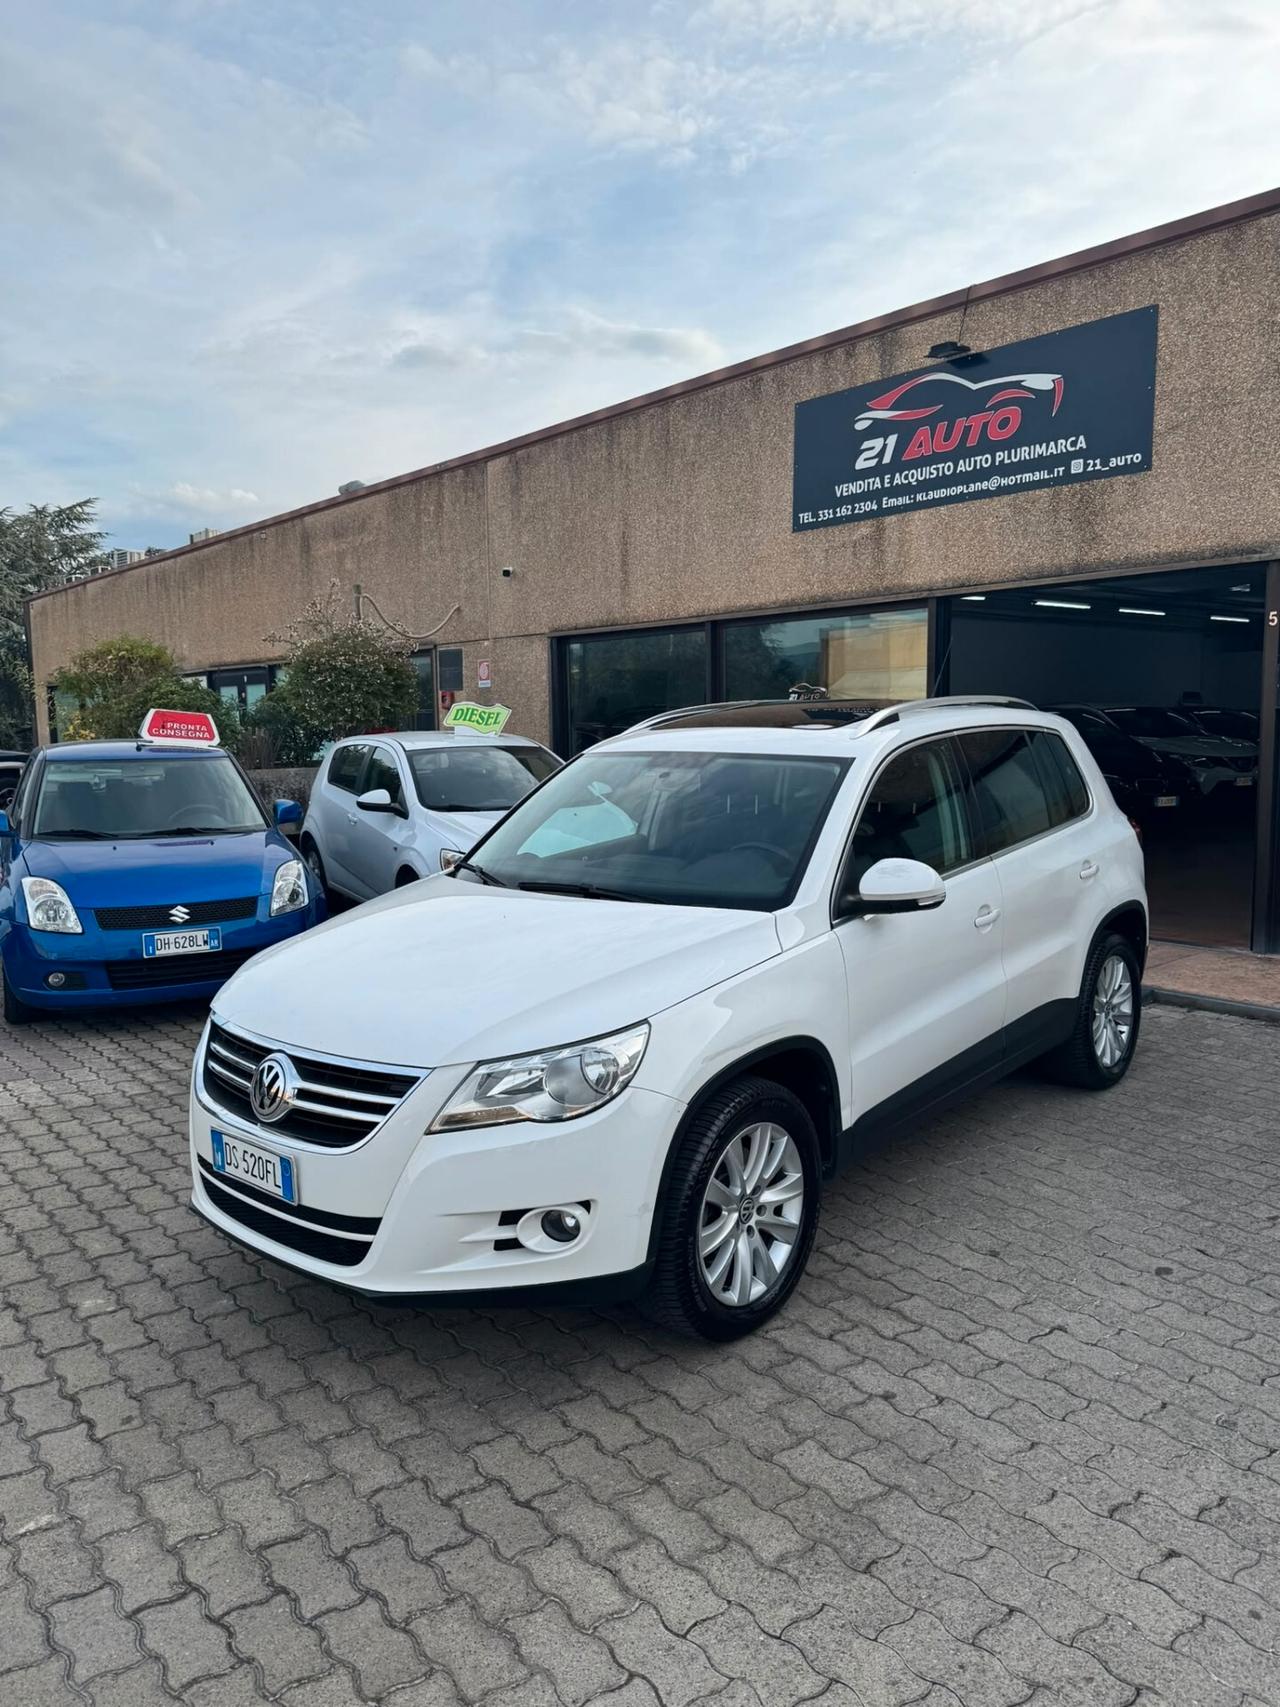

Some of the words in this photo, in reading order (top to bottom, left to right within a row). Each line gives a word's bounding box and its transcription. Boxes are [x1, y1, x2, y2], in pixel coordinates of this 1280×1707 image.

[854, 433, 898, 470] 21
[902, 405, 1022, 461] AUTO
[835, 477, 881, 498] VENDITA
[884, 474, 891, 487] E
[893, 461, 954, 485] ACQUISTO
[957, 453, 992, 474] AUTO
[995, 435, 1087, 466] PLURIMARCA
[799, 511, 816, 524] TEL.
[817, 508, 834, 521] 331
[836, 504, 852, 517] 162
[854, 500, 878, 514] 2304
[1268, 611, 1278, 626] 5
[453, 708, 501, 726] DIESEL
[152, 728, 210, 738] CONSEGNA
[167, 722, 207, 731] PRONTA
[156, 938, 171, 951] DH
[174, 934, 209, 950] 628LW
[224, 1142, 239, 1169] DS
[243, 1150, 281, 1189] 520FL
